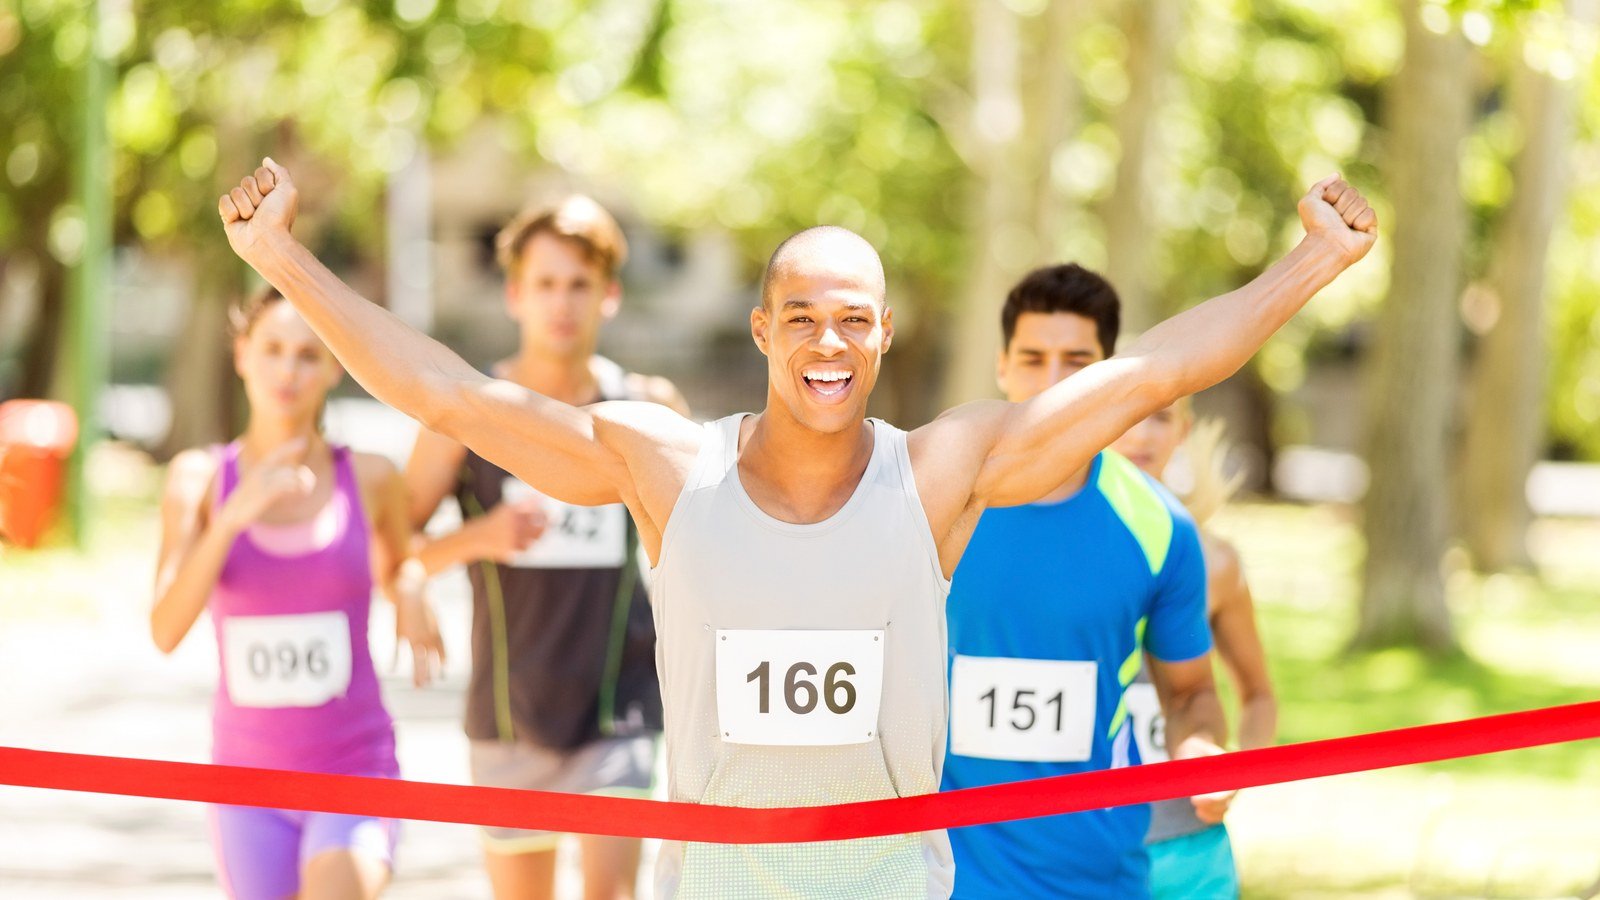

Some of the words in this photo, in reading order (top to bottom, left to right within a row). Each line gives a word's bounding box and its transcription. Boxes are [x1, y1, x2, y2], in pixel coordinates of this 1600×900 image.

[246, 638, 331, 681] 096
[746, 660, 857, 715] 166
[978, 686, 1064, 732] 151
